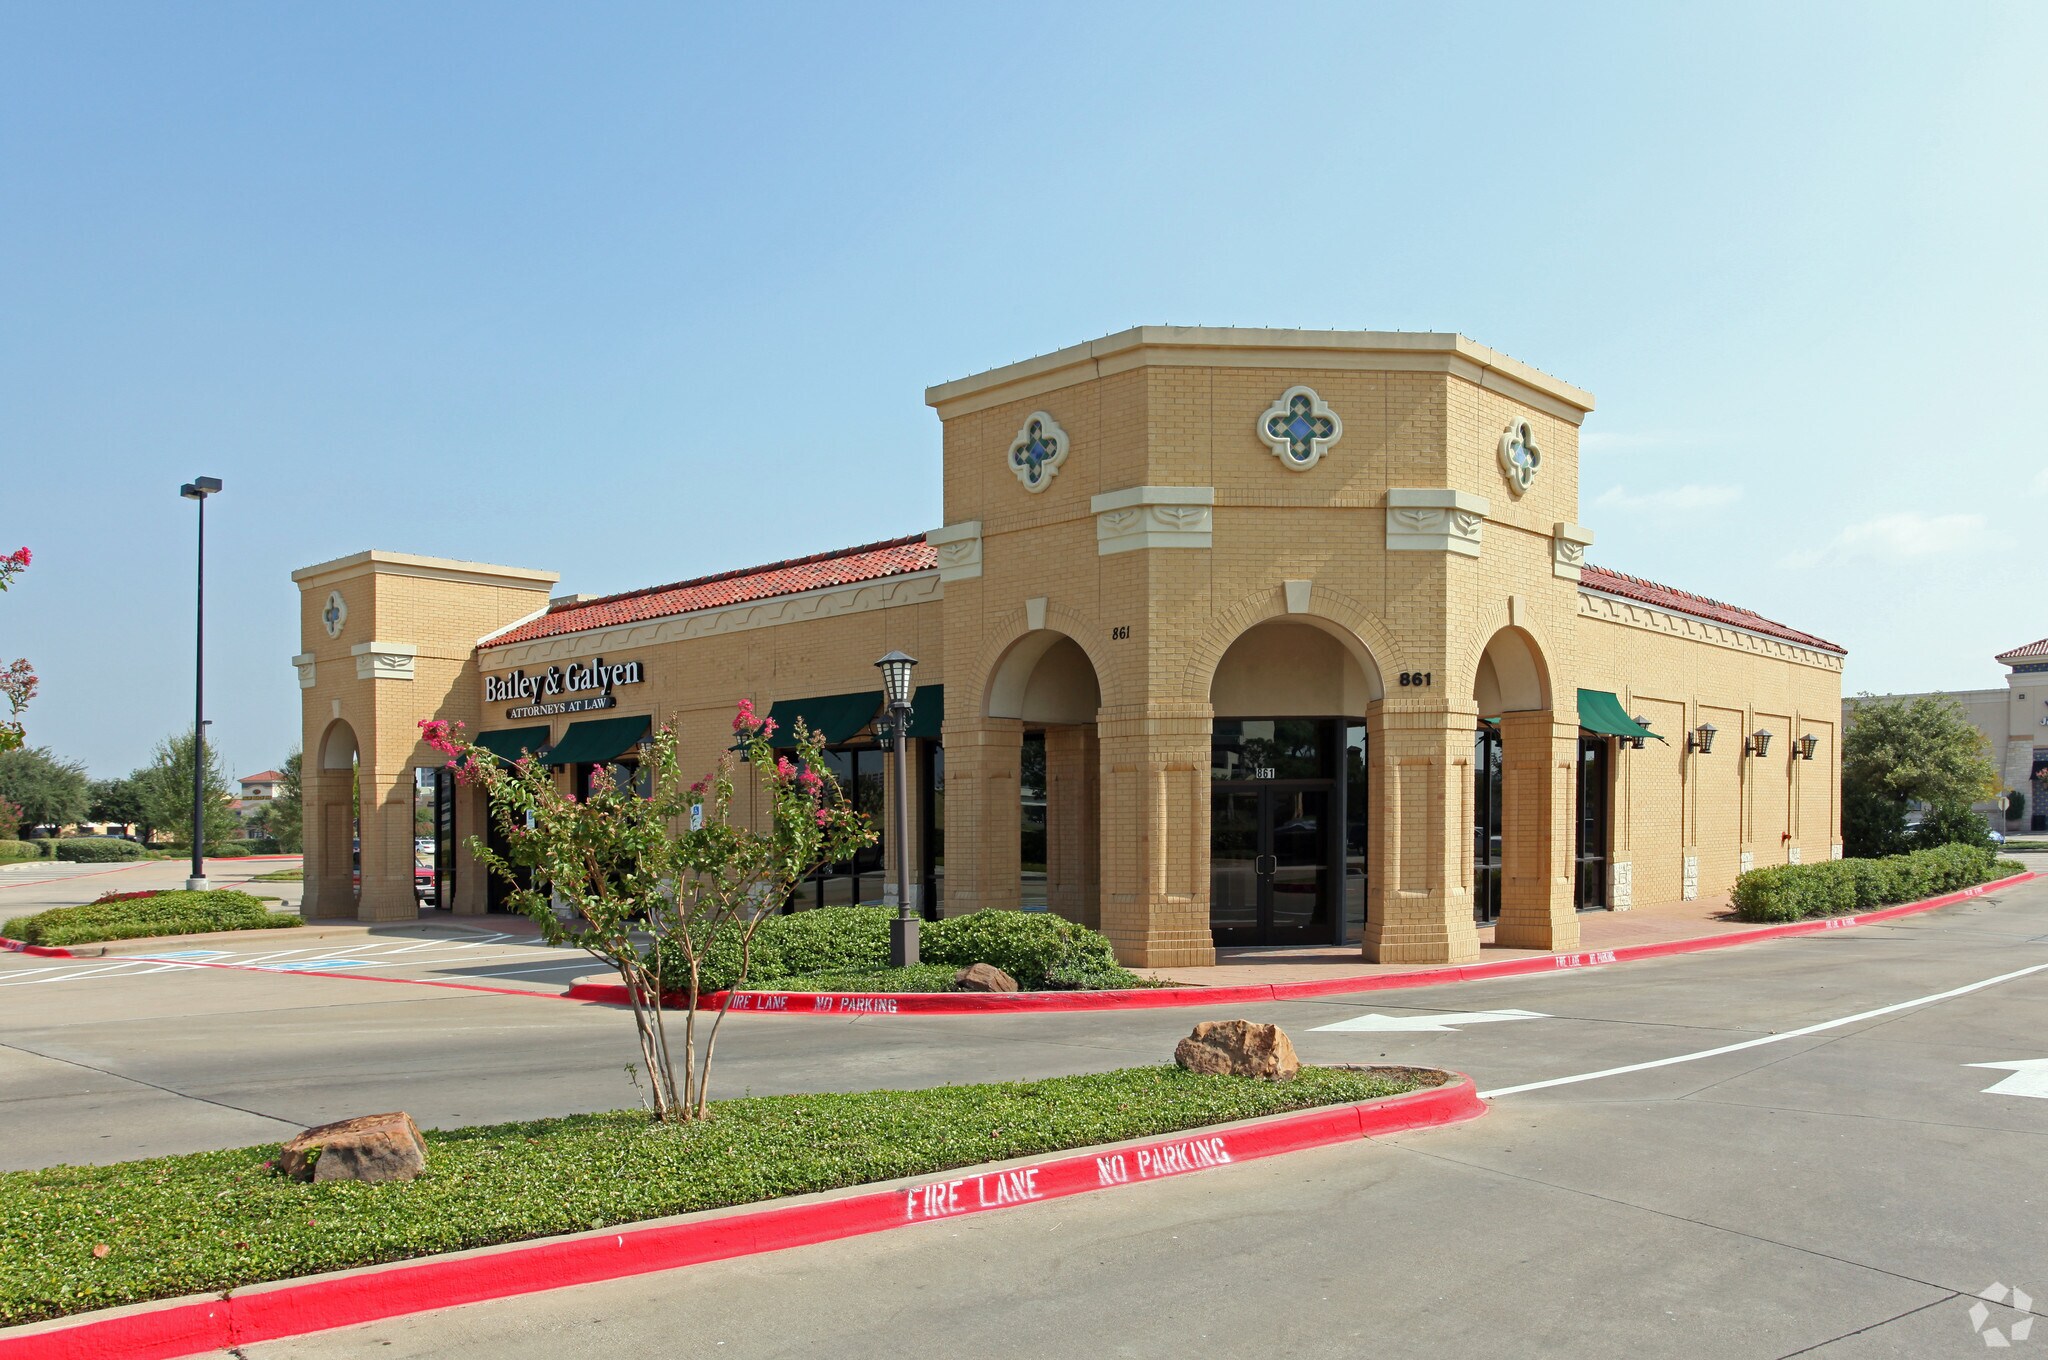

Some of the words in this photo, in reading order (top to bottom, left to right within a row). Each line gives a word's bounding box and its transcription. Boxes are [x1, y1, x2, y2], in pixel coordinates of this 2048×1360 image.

[1112, 625, 1130, 640] 861
[485, 669, 543, 704] Bailey
[545, 665, 562, 695] &
[565, 657, 640, 696] Galyen
[1399, 672, 1431, 686] 861
[510, 702, 566, 719] ATTORNEYS
[568, 700, 582, 712] AT
[584, 697, 607, 711] LAW
[1257, 768, 1274, 779] 861
[730, 995, 752, 1009] IRE
[757, 995, 789, 1010] LANE
[814, 996, 833, 1011] NO
[840, 997, 898, 1013] PARKING
[906, 1180, 966, 1220] FIRE
[977, 1168, 1043, 1208] LANE
[1096, 1154, 1128, 1186] NO
[1137, 1137, 1231, 1179] PARKING
